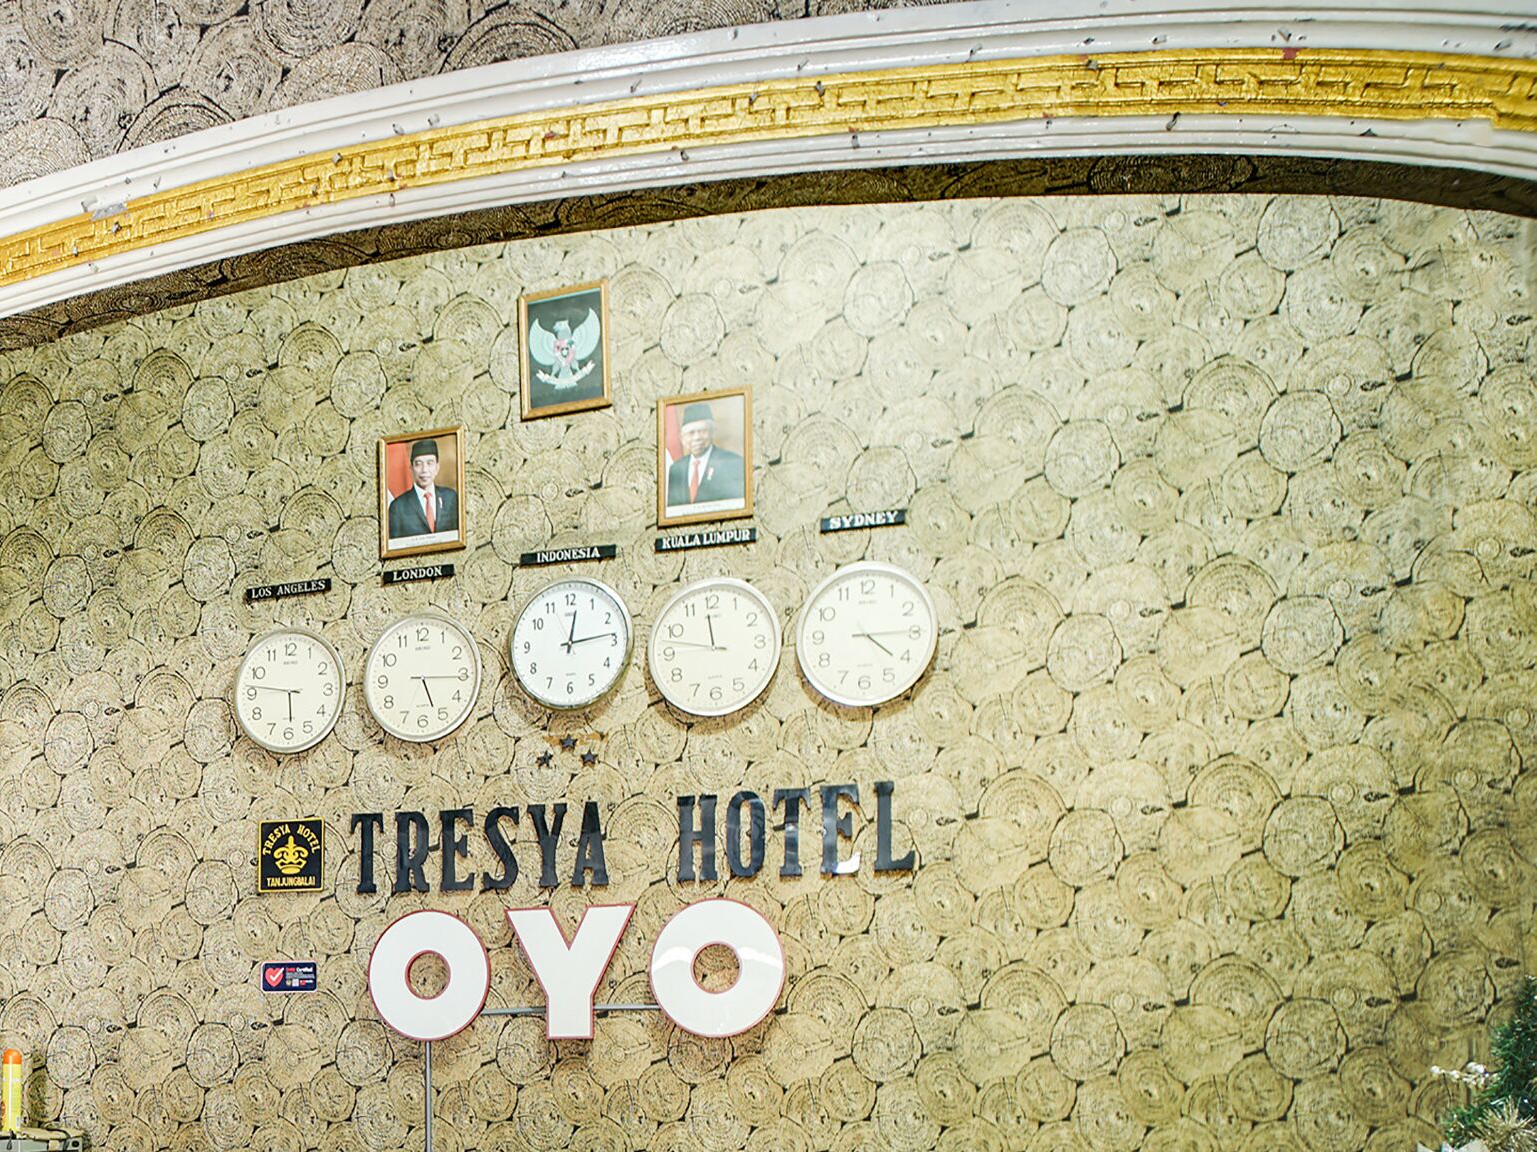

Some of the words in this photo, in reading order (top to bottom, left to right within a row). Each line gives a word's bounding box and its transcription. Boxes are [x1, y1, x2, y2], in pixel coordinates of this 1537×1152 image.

[830, 511, 899, 530] SYDNEY
[662, 535, 701, 549] KUALA
[703, 529, 751, 544] LUMPUR
[536, 547, 601, 563] INDONESIA
[393, 566, 443, 582] LONDON
[252, 586, 272, 599] LOS
[277, 580, 326, 596] ANGELES
[839, 587, 849, 601] 11
[860, 580, 876, 595] 12
[890, 585, 894, 599] 1
[565, 594, 577, 606] 12
[591, 599, 594, 610] 1
[705, 595, 720, 610] 12
[734, 598, 738, 611] 1
[545, 602, 555, 614] 11
[685, 604, 695, 617] 11
[820, 607, 836, 622] 10
[903, 601, 914, 617] 2
[532, 618, 544, 630] 10
[605, 612, 611, 624] 2
[747, 612, 758, 627] 2
[416, 628, 429, 642] 12
[441, 631, 445, 644] 1
[668, 623, 684, 639] 10
[812, 631, 825, 645] 9
[909, 625, 921, 640] 3
[398, 636, 408, 648] 11
[611, 633, 618, 647] 3
[754, 635, 766, 649] 3
[284, 643, 297, 657] 12
[308, 647, 312, 659] 1
[452, 646, 462, 660] 2
[524, 641, 531, 654] 9
[664, 647, 675, 661] 9
[267, 649, 277, 662] 11
[383, 653, 397, 668] 10
[604, 657, 610, 668] 4
[819, 653, 831, 667] 8
[900, 650, 911, 664] 4
[318, 662, 328, 675] 2
[530, 662, 537, 675] 8
[748, 658, 758, 672] 4
[252, 666, 266, 680] 10
[458, 667, 469, 681] 3
[589, 674, 595, 686] 5
[671, 668, 683, 682] 8
[838, 671, 849, 685] 7
[883, 668, 896, 683] 5
[378, 675, 389, 689] 9
[547, 677, 553, 689] 7
[567, 682, 574, 694] 6
[733, 678, 745, 691] 5
[858, 675, 871, 690] 6
[247, 687, 257, 701] 9
[323, 683, 334, 697] 3
[452, 689, 462, 703] 4
[689, 684, 700, 697] 7
[710, 687, 722, 701] 6
[384, 695, 394, 709] 8
[252, 707, 262, 720] 8
[317, 705, 326, 718] 4
[400, 711, 410, 724] 7
[438, 708, 449, 721] 5
[303, 721, 314, 734] 5
[417, 715, 429, 728] 6
[267, 723, 276, 736] 7
[284, 727, 294, 740] 6
[263, 824, 291, 856] TRESYA
[297, 824, 321, 854] HOTEL
[351, 801, 609, 894] TRESYA
[676, 780, 915, 882] HOTEL
[267, 876, 316, 888] TANJUNGBALAI
[368, 898, 785, 1041] OYO
